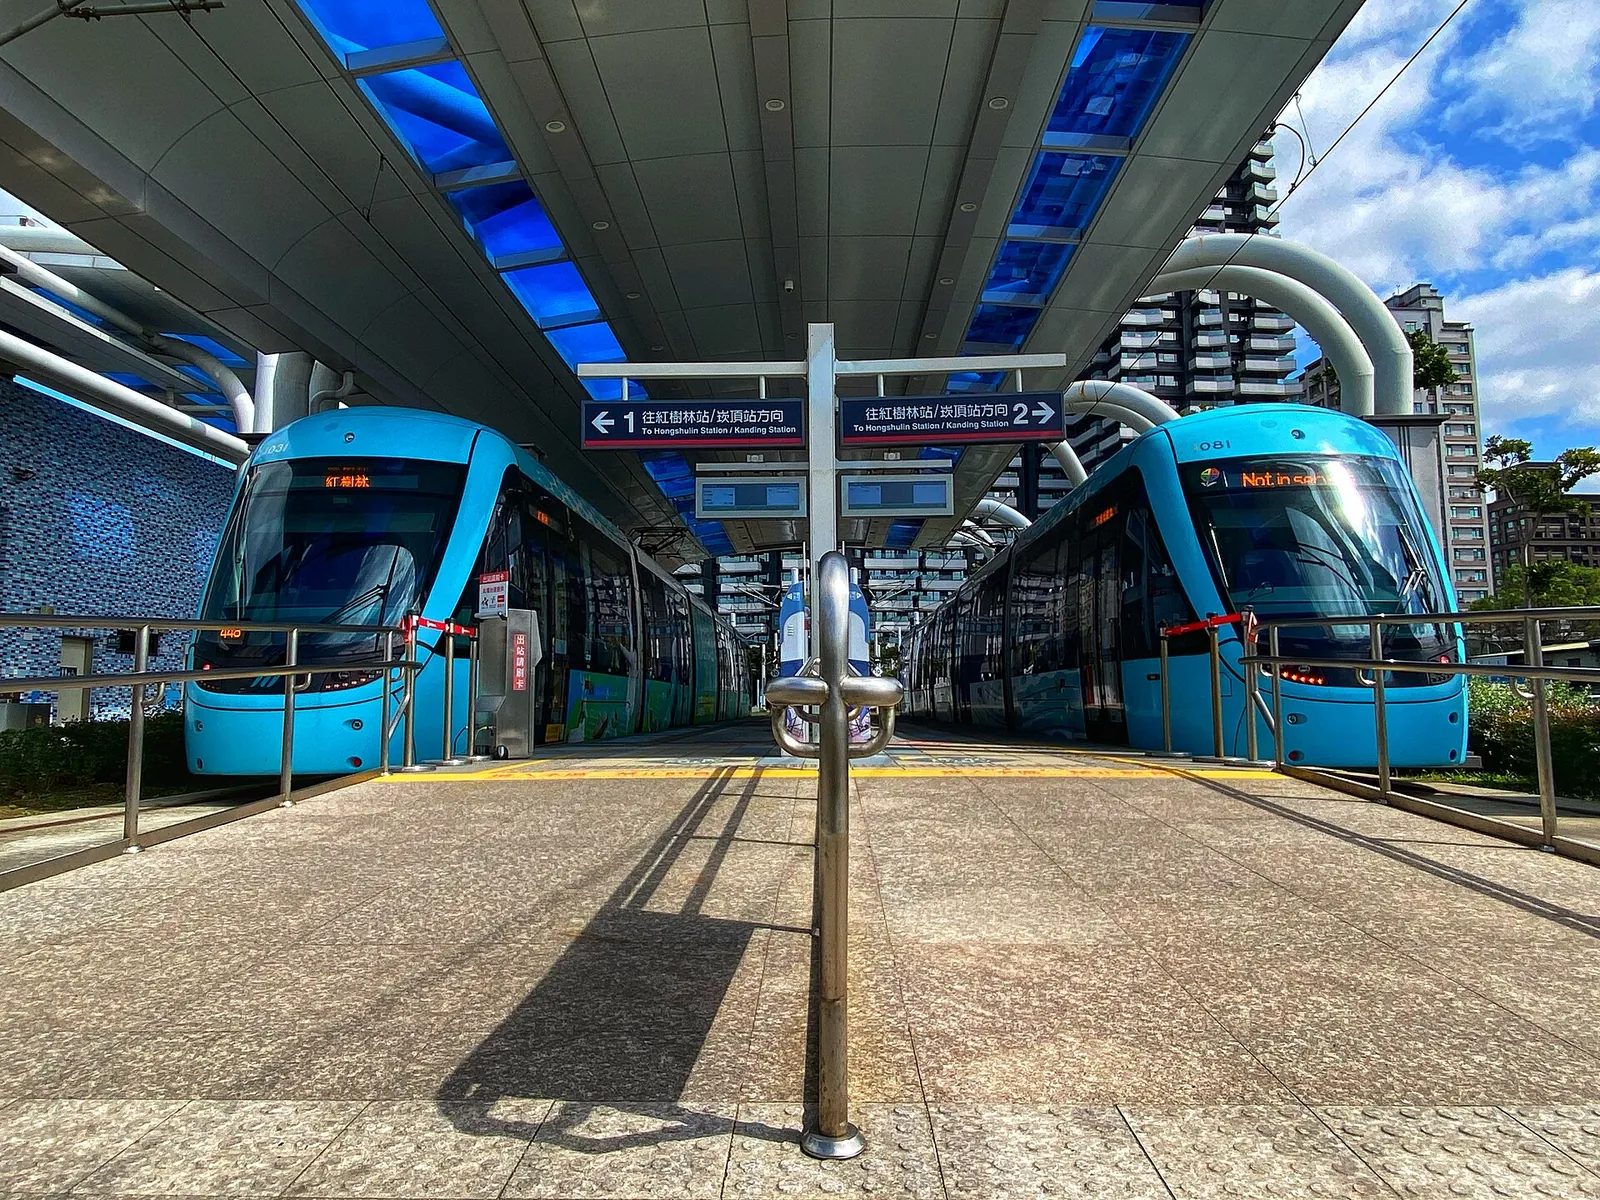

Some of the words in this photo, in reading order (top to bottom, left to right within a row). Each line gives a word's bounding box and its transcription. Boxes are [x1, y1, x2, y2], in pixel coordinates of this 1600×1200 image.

[641, 408, 784, 424] 往紅樹林站/崁頂站方向
[865, 403, 1008, 421] 往紅樹林站/崁頂站方向
[1012, 402, 1029, 425] 2
[623, 411, 634, 433] 1
[853, 424, 864, 432] To
[865, 423, 911, 433] Hongshulin
[912, 422, 940, 430] Station
[946, 421, 979, 430] Kanding
[980, 420, 1009, 428] Station
[641, 427, 652, 435] To
[653, 426, 698, 436] Hongshulin
[700, 426, 728, 434] Station
[734, 426, 767, 435] Kanding
[768, 425, 796, 434] Station
[1276, 472, 1291, 485] in
